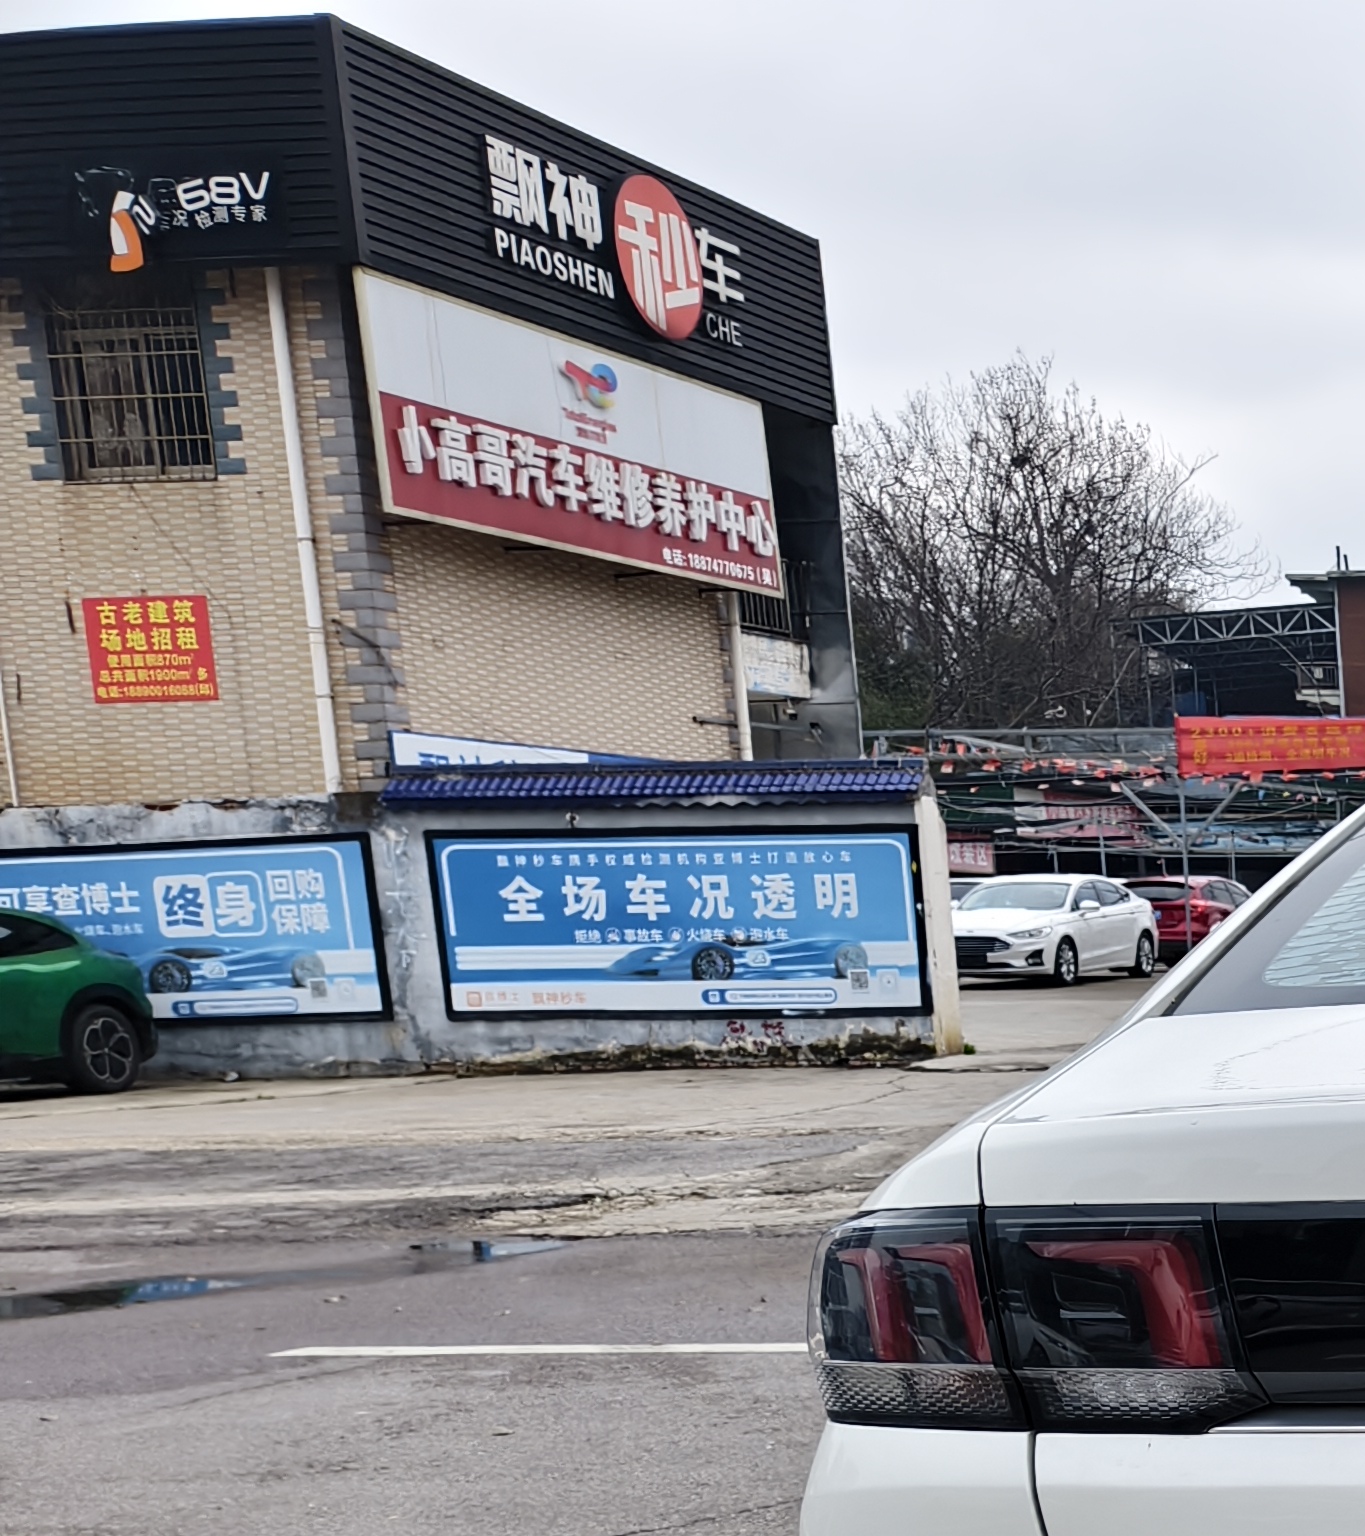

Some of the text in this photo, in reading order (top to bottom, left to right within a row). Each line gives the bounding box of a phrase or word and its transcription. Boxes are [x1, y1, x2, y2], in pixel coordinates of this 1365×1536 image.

[494, 227, 743, 347] PIAOSHEN CHE
[397, 405, 775, 557] 小高哥汽车维修养护中心
[96, 600, 196, 625] 古老建筑
[99, 627, 199, 651] 场地招租
[266, 869, 325, 902] 回购
[498, 873, 860, 922] 全场车况透明
[162, 883, 256, 928] 终身
[272, 904, 330, 935] 保障
[623, 929, 664, 943] 事故车
